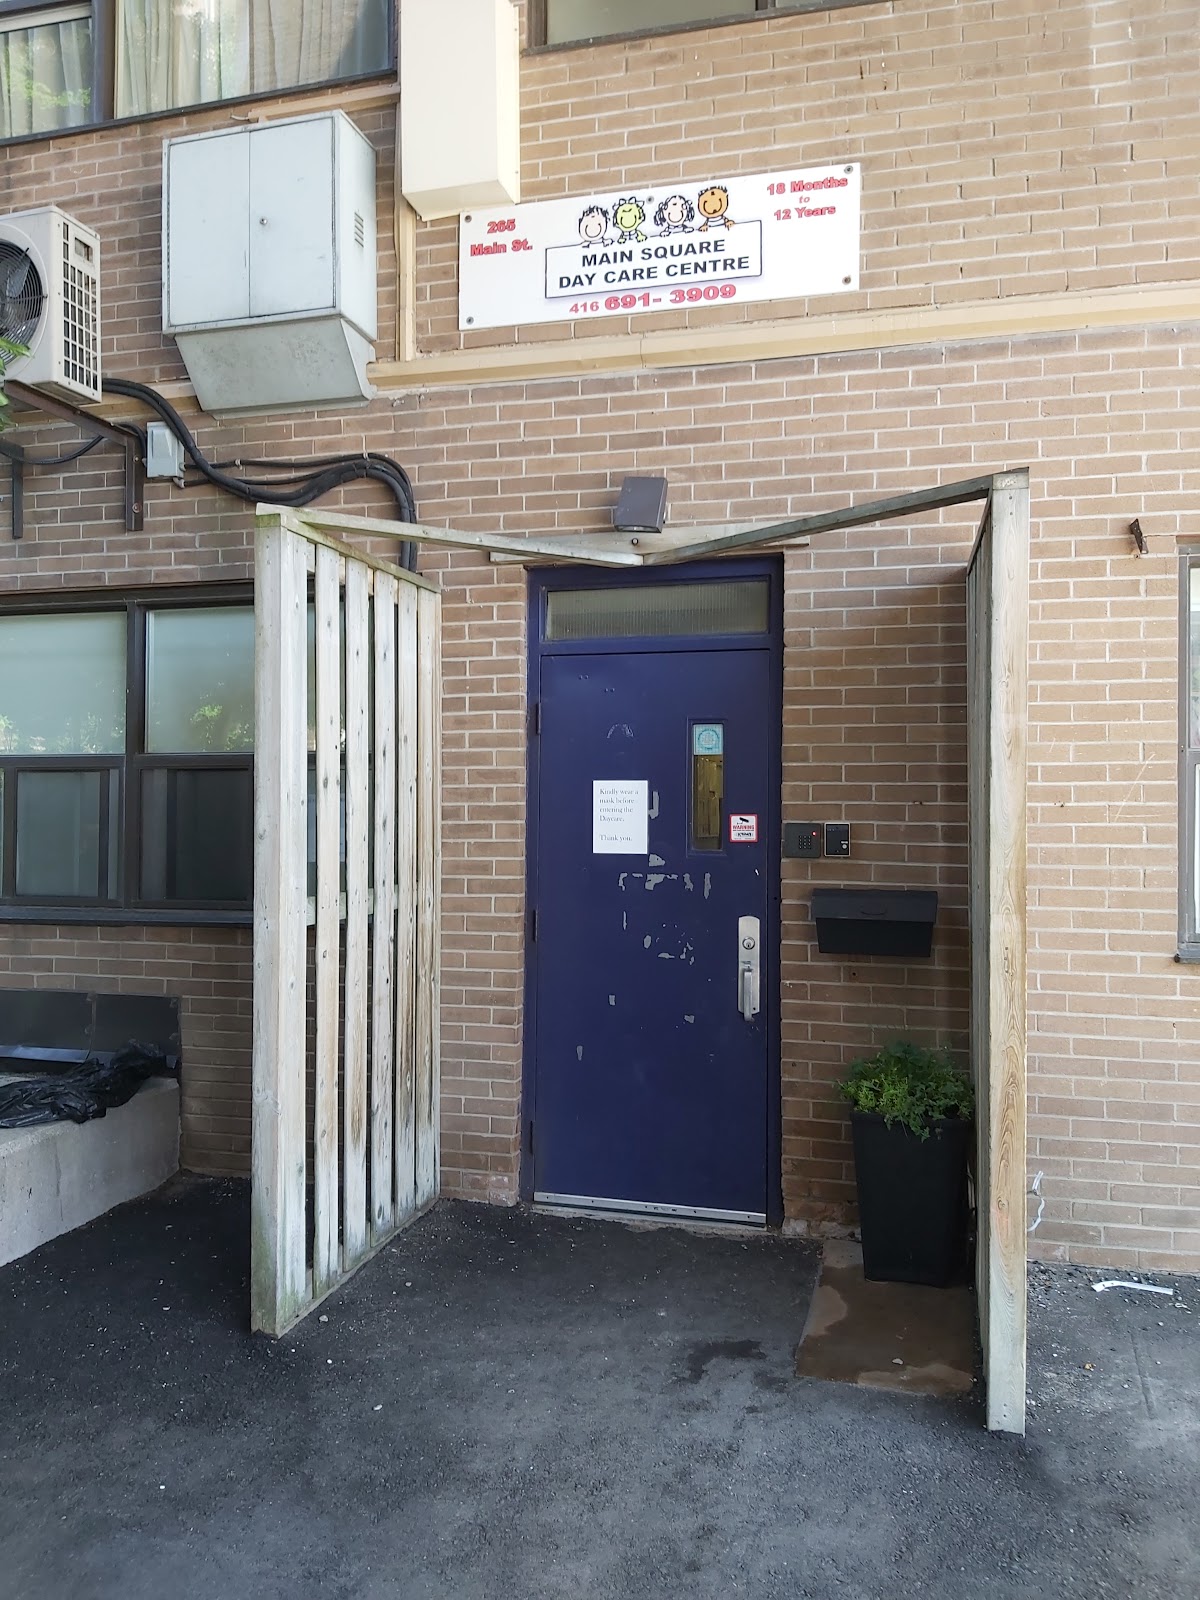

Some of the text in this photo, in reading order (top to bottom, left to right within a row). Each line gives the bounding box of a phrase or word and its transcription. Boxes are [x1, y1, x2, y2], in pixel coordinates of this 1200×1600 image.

[767, 176, 848, 196] 18 Months
[799, 195, 810, 204] to
[774, 205, 836, 221] 12 Years
[487, 218, 516, 234] 265
[470, 238, 533, 257] Main St.
[581, 239, 726, 267] MAIN SQUARE
[559, 256, 750, 289] DAY CARE CENTRE
[569, 301, 600, 314] 416
[669, 284, 737, 304] 3909
[600, 788, 618, 796] Kindly
